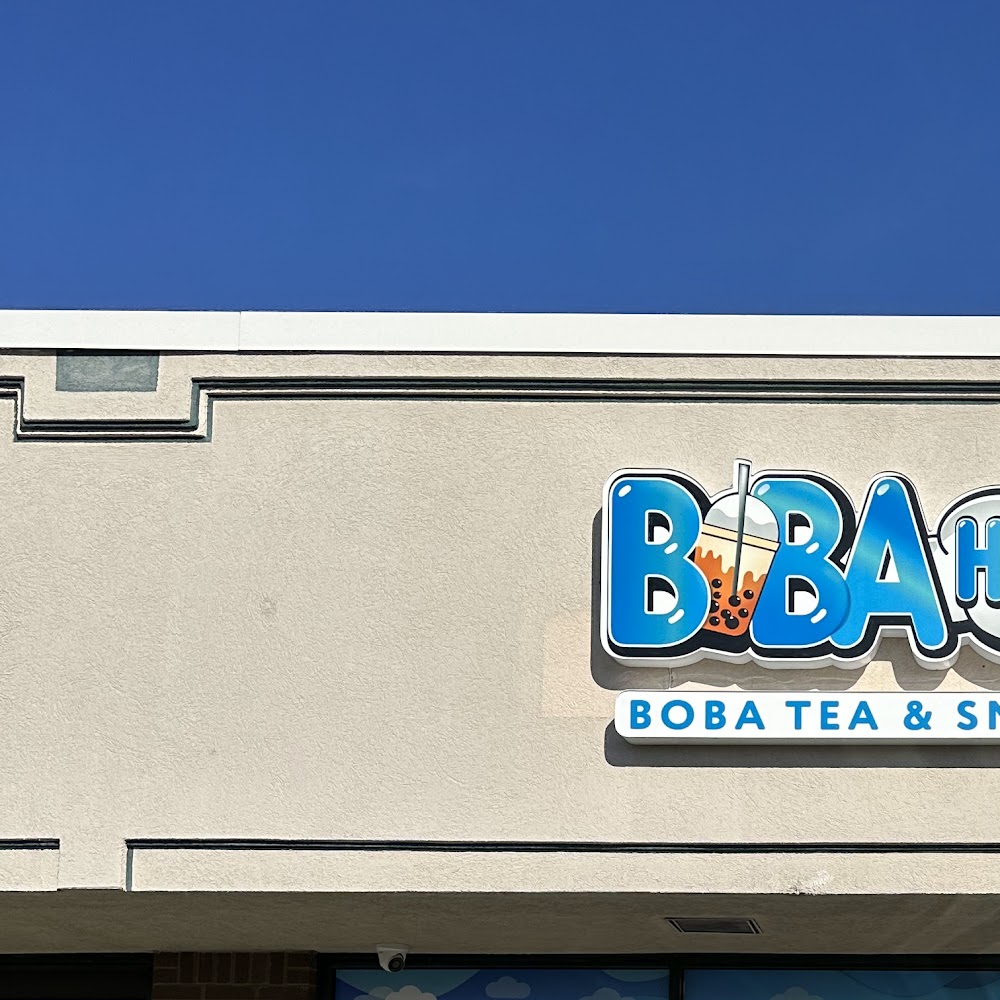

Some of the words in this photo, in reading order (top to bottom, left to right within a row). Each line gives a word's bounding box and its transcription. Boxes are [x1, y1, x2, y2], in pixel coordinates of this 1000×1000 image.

[629, 699, 765, 731] BOBA
[785, 699, 879, 731] TEA
[903, 699, 932, 731] &
